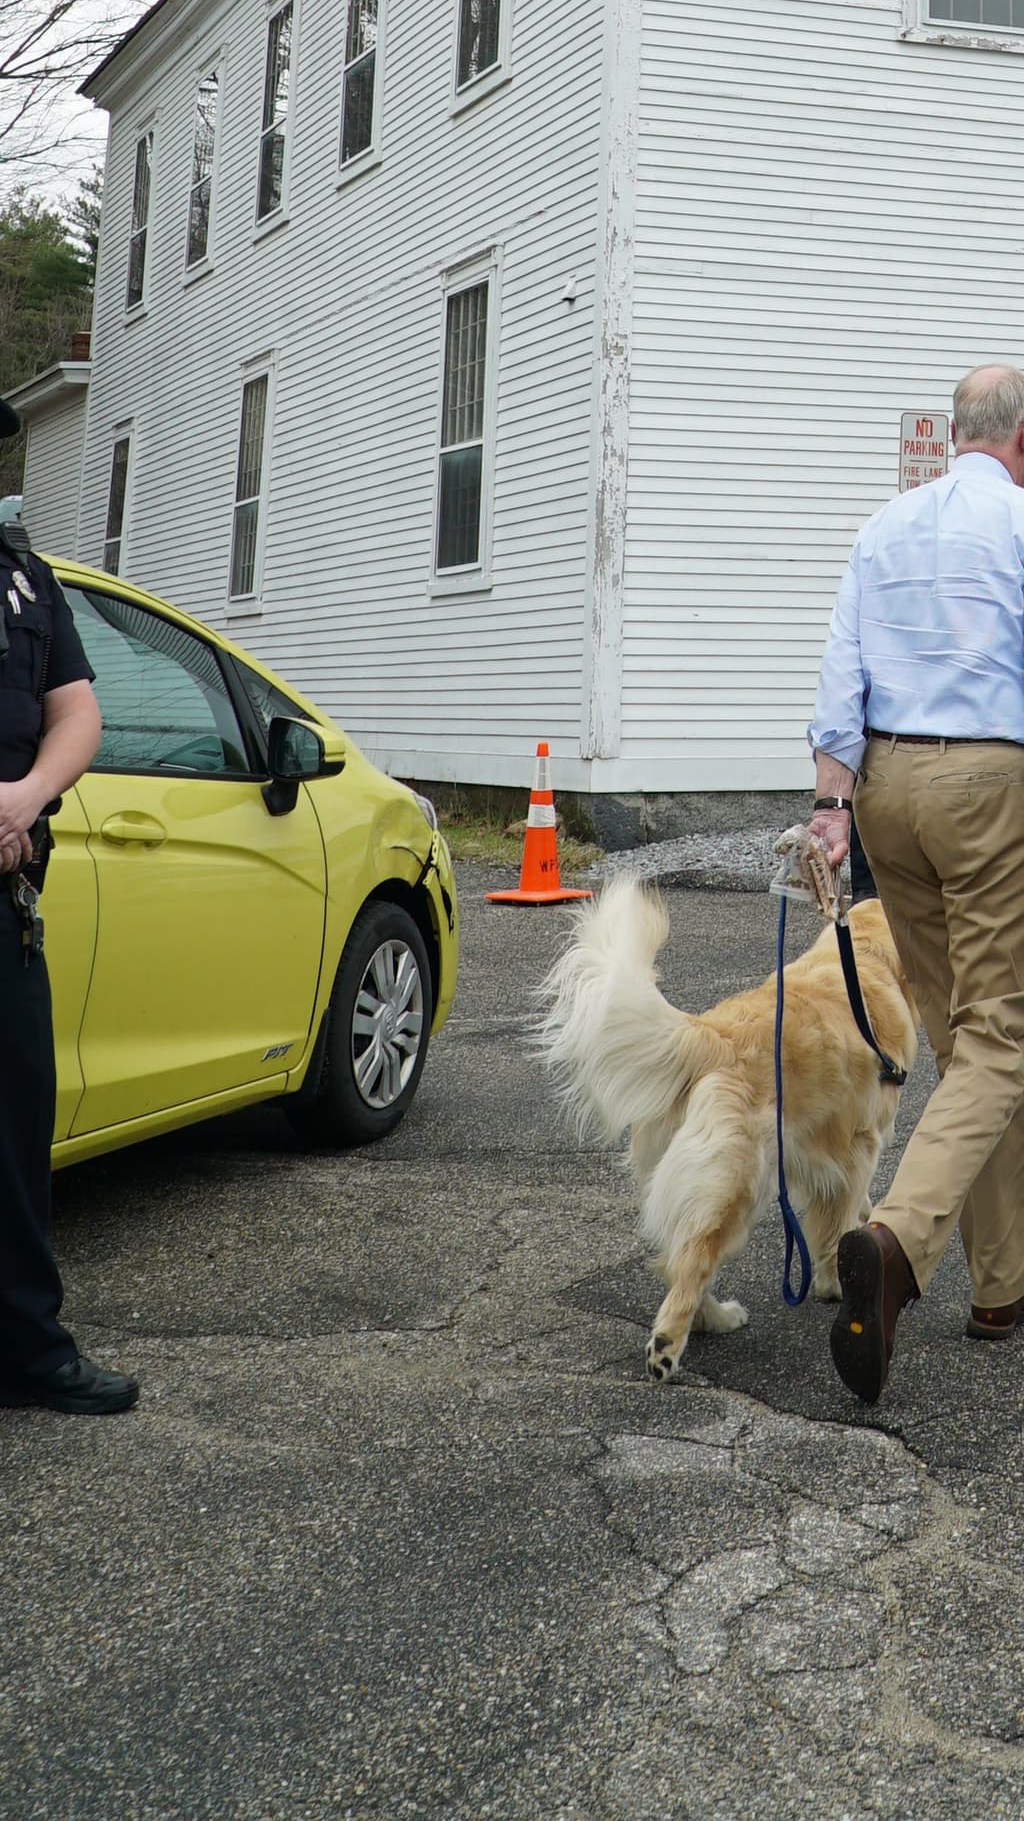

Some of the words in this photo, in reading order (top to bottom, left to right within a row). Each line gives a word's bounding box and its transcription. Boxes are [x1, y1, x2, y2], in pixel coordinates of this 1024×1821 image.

[915, 418, 933, 438] NO
[904, 440, 944, 457] PARKING
[904, 466, 920, 477] FIRE
[924, 467, 943, 478] LANE
